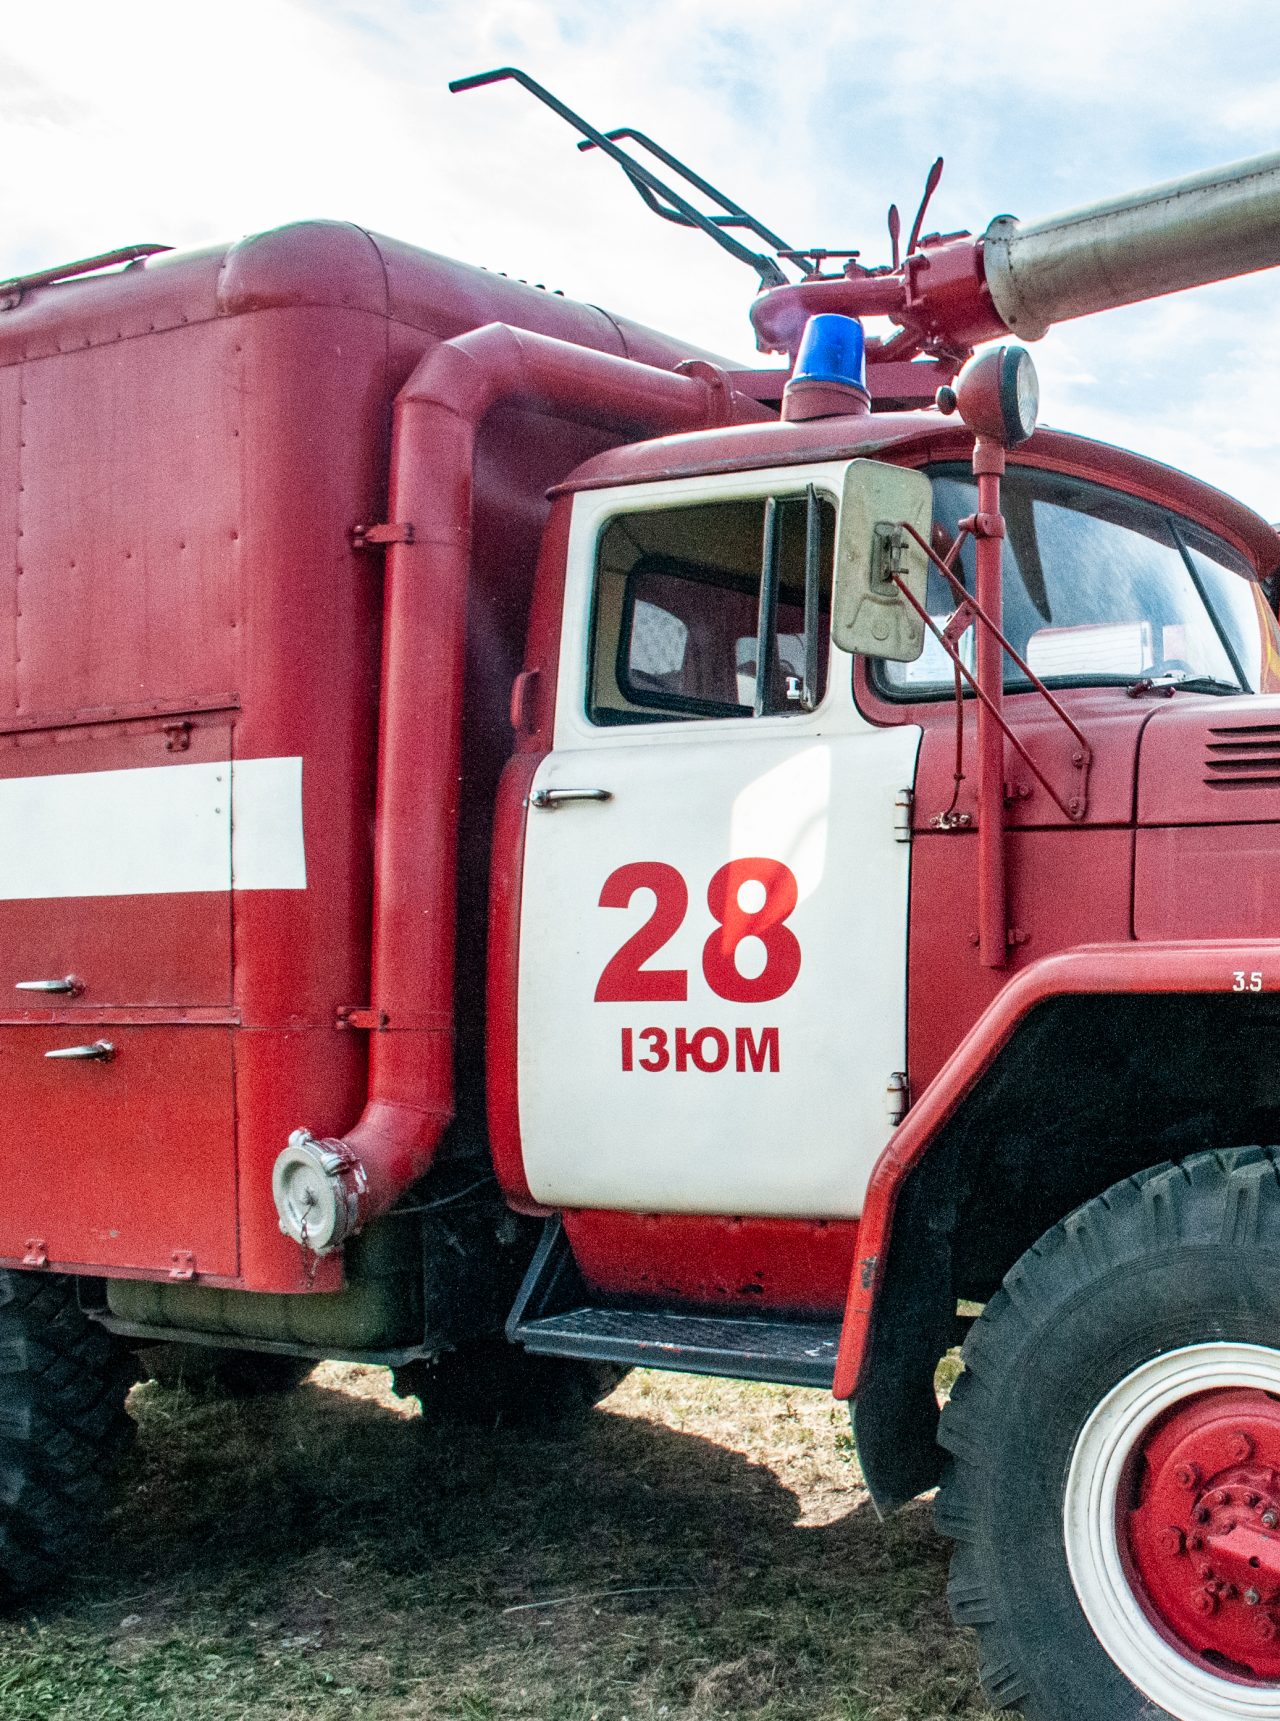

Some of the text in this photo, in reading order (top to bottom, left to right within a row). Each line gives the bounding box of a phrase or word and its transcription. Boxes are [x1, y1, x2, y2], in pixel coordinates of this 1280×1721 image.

[594, 857, 802, 1003] 28
[1232, 971, 1263, 992] 3.5
[621, 1027, 780, 1073] ІЗЮМ
